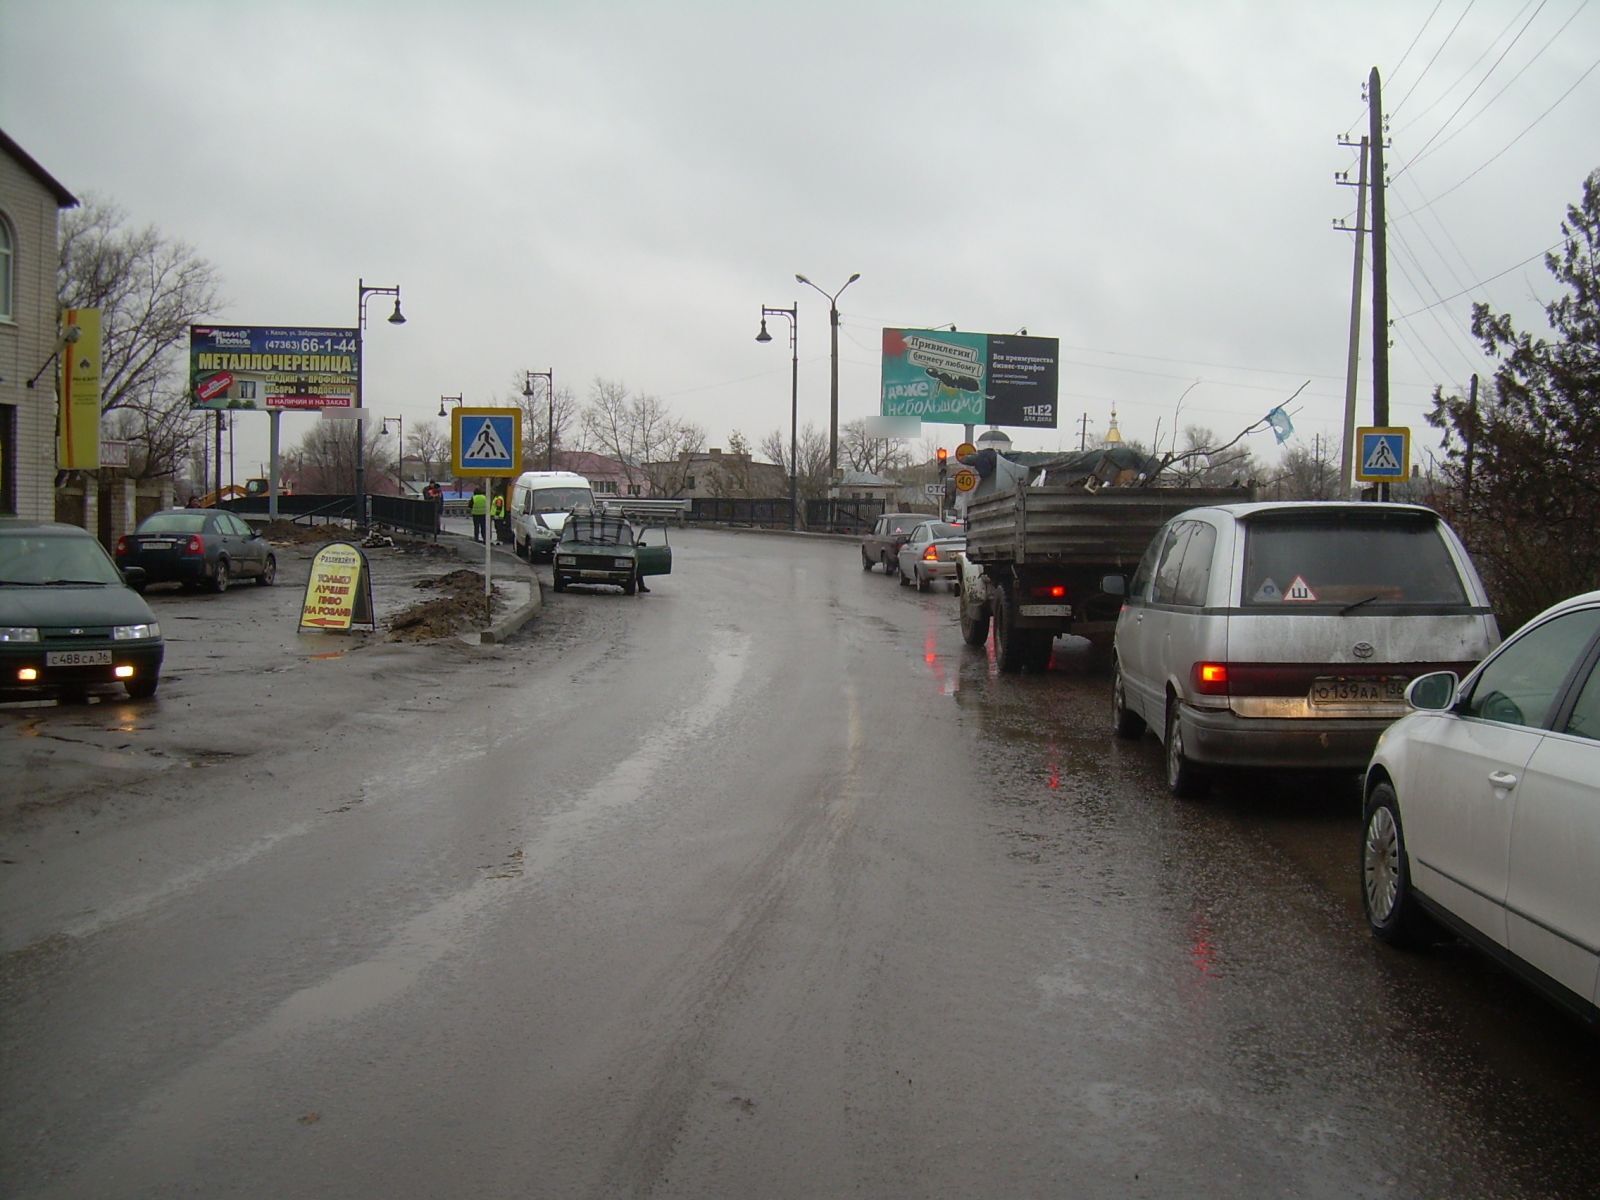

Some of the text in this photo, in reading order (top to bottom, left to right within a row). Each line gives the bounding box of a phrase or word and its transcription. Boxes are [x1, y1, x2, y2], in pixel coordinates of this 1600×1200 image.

[265, 338, 357, 352] (47363) 66-1-44
[911, 336, 970, 359] Привилегии
[198, 353, 352, 373] МЕТАЛЛОЧЕРЕПИЦА
[913, 351, 977, 374] бизнесу любому
[264, 385, 297, 395] ЗАБОРЫ
[888, 380, 929, 399] даже
[888, 394, 984, 416] небольшому
[1023, 404, 1052, 416] TELE2
[958, 475, 972, 486] 40
[927, 485, 946, 493] СТО
[318, 574, 351, 584] ТОЛЬКО
[1291, 587, 1308, 598] Ш
[318, 596, 342, 605] ПИВО
[304, 606, 316, 615] НА
